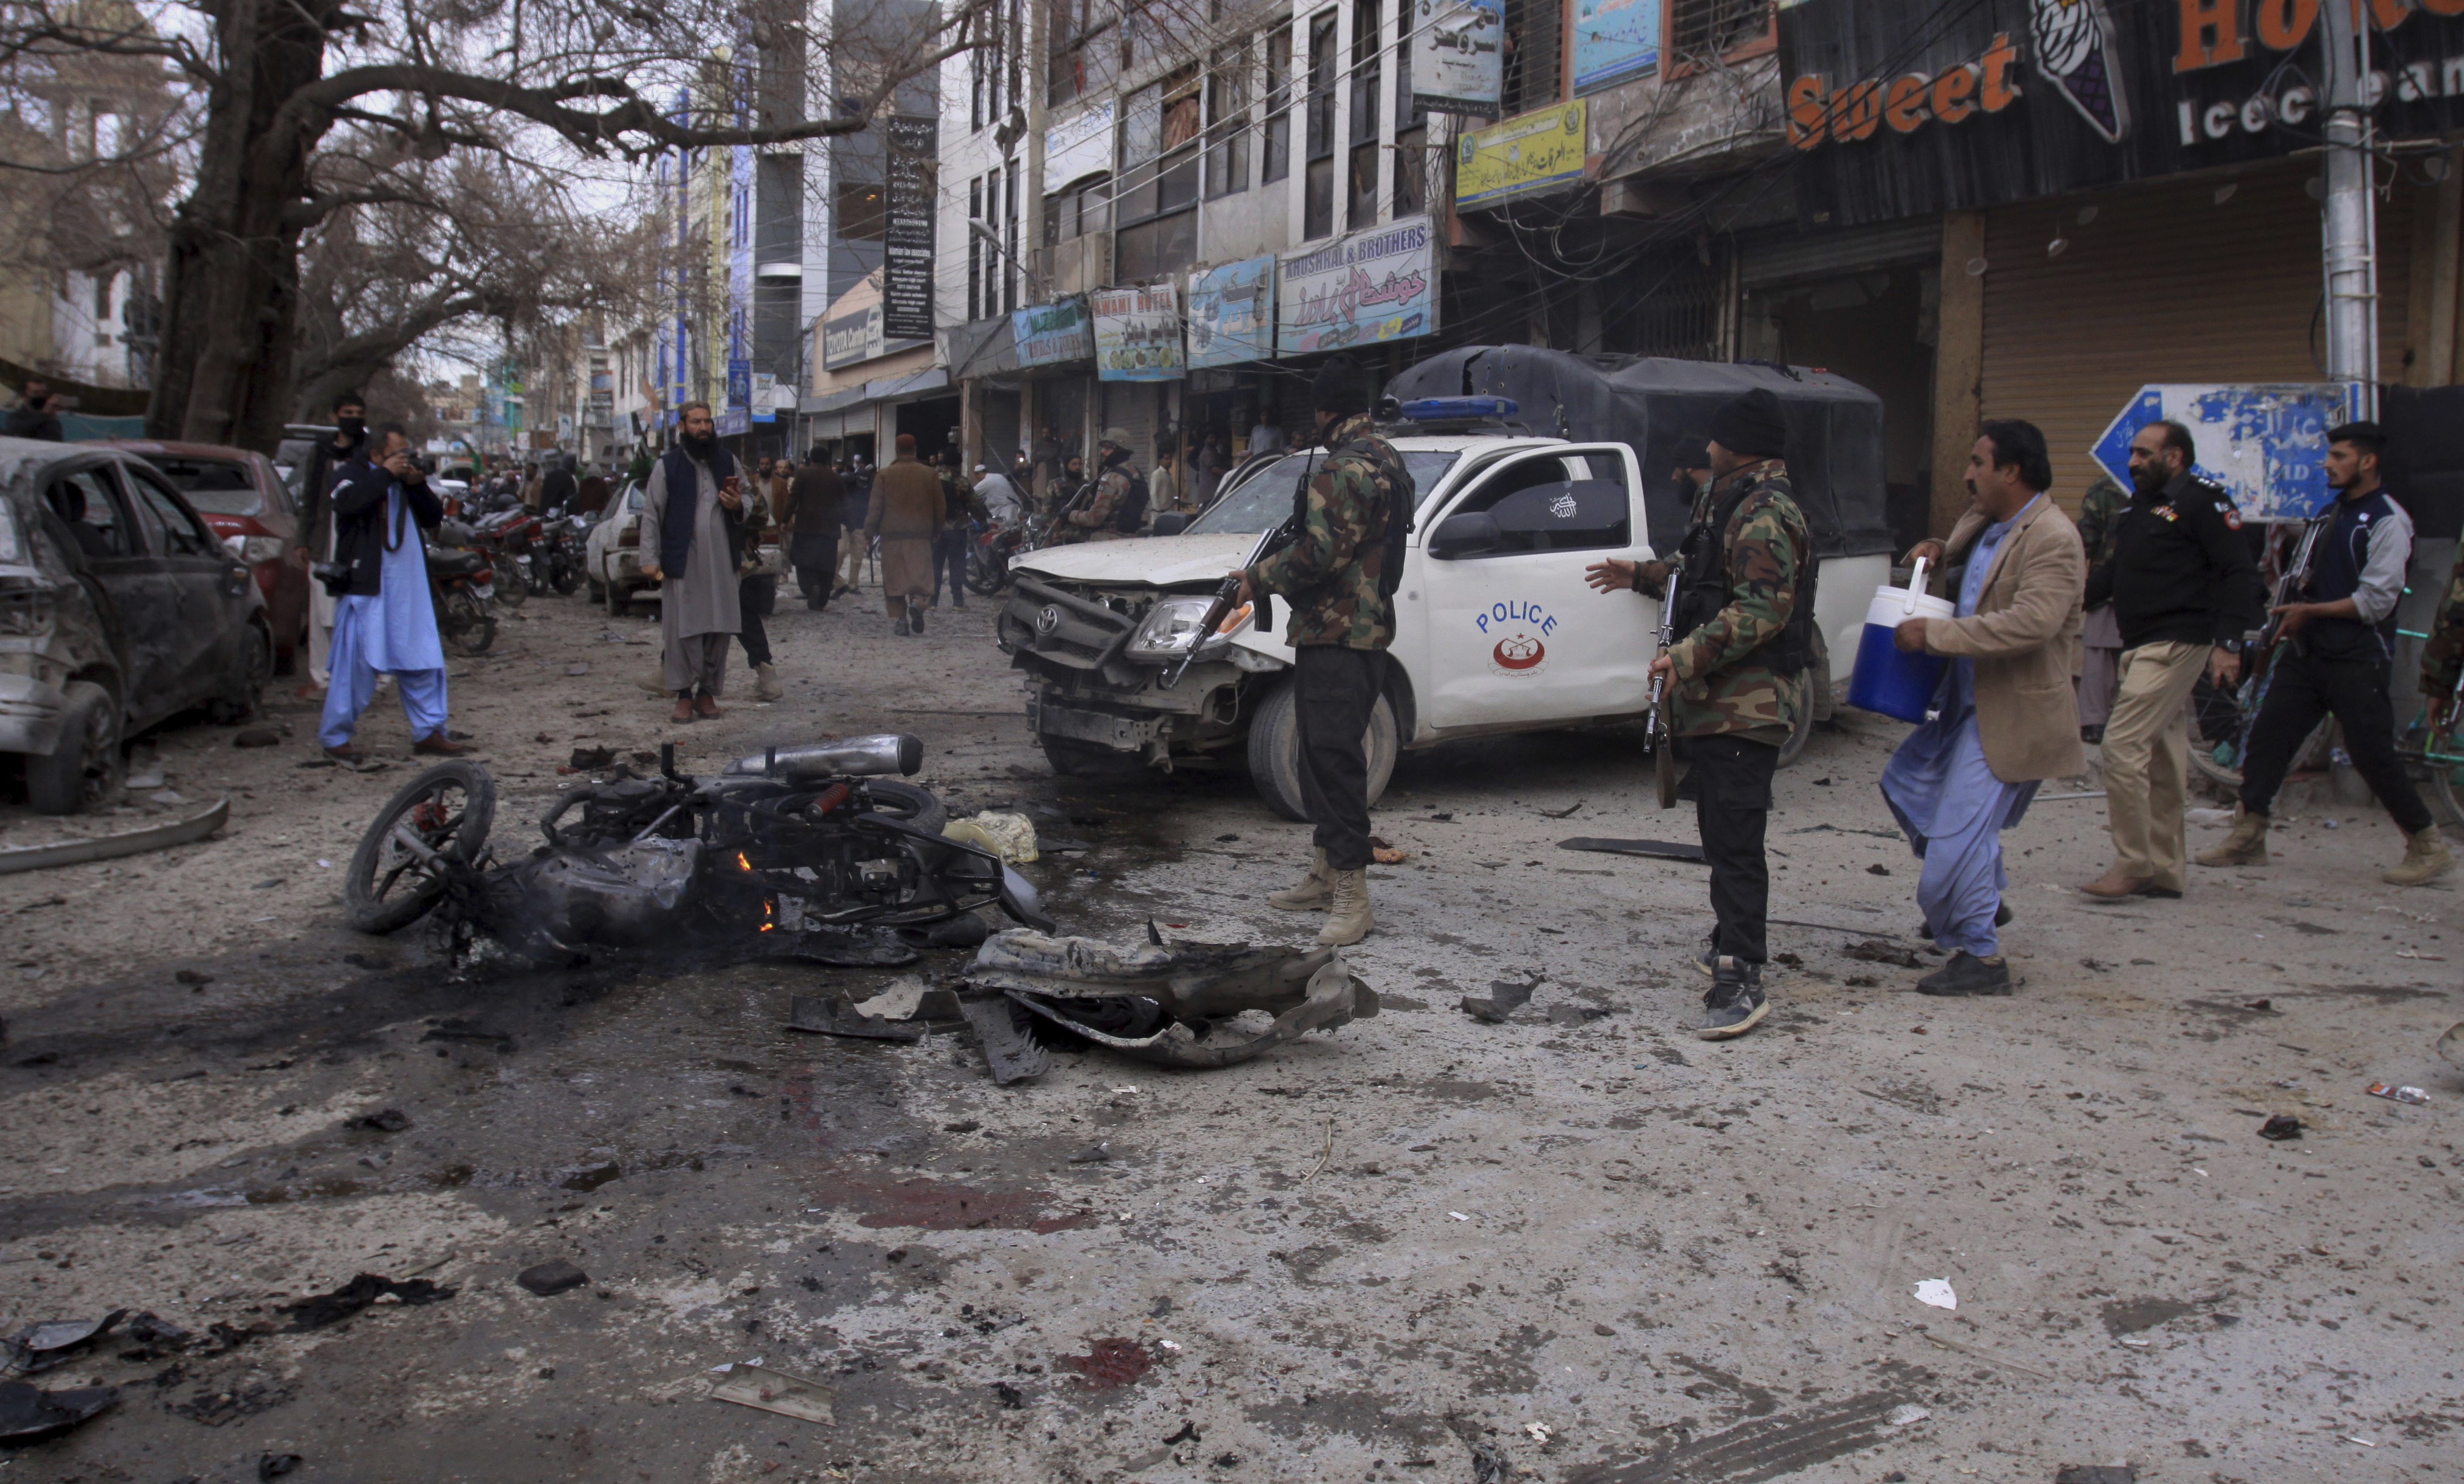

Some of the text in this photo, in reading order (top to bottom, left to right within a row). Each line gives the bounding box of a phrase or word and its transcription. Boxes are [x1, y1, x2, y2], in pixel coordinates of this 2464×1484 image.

[1787, 32, 2020, 150] Sweet
[1285, 223, 1427, 280] KHUSHHAL & BROTHERS
[1094, 288, 1173, 317] AWAMI HOTEL
[826, 330, 848, 355] TOYOTA
[1476, 600, 1558, 637] POLICE
